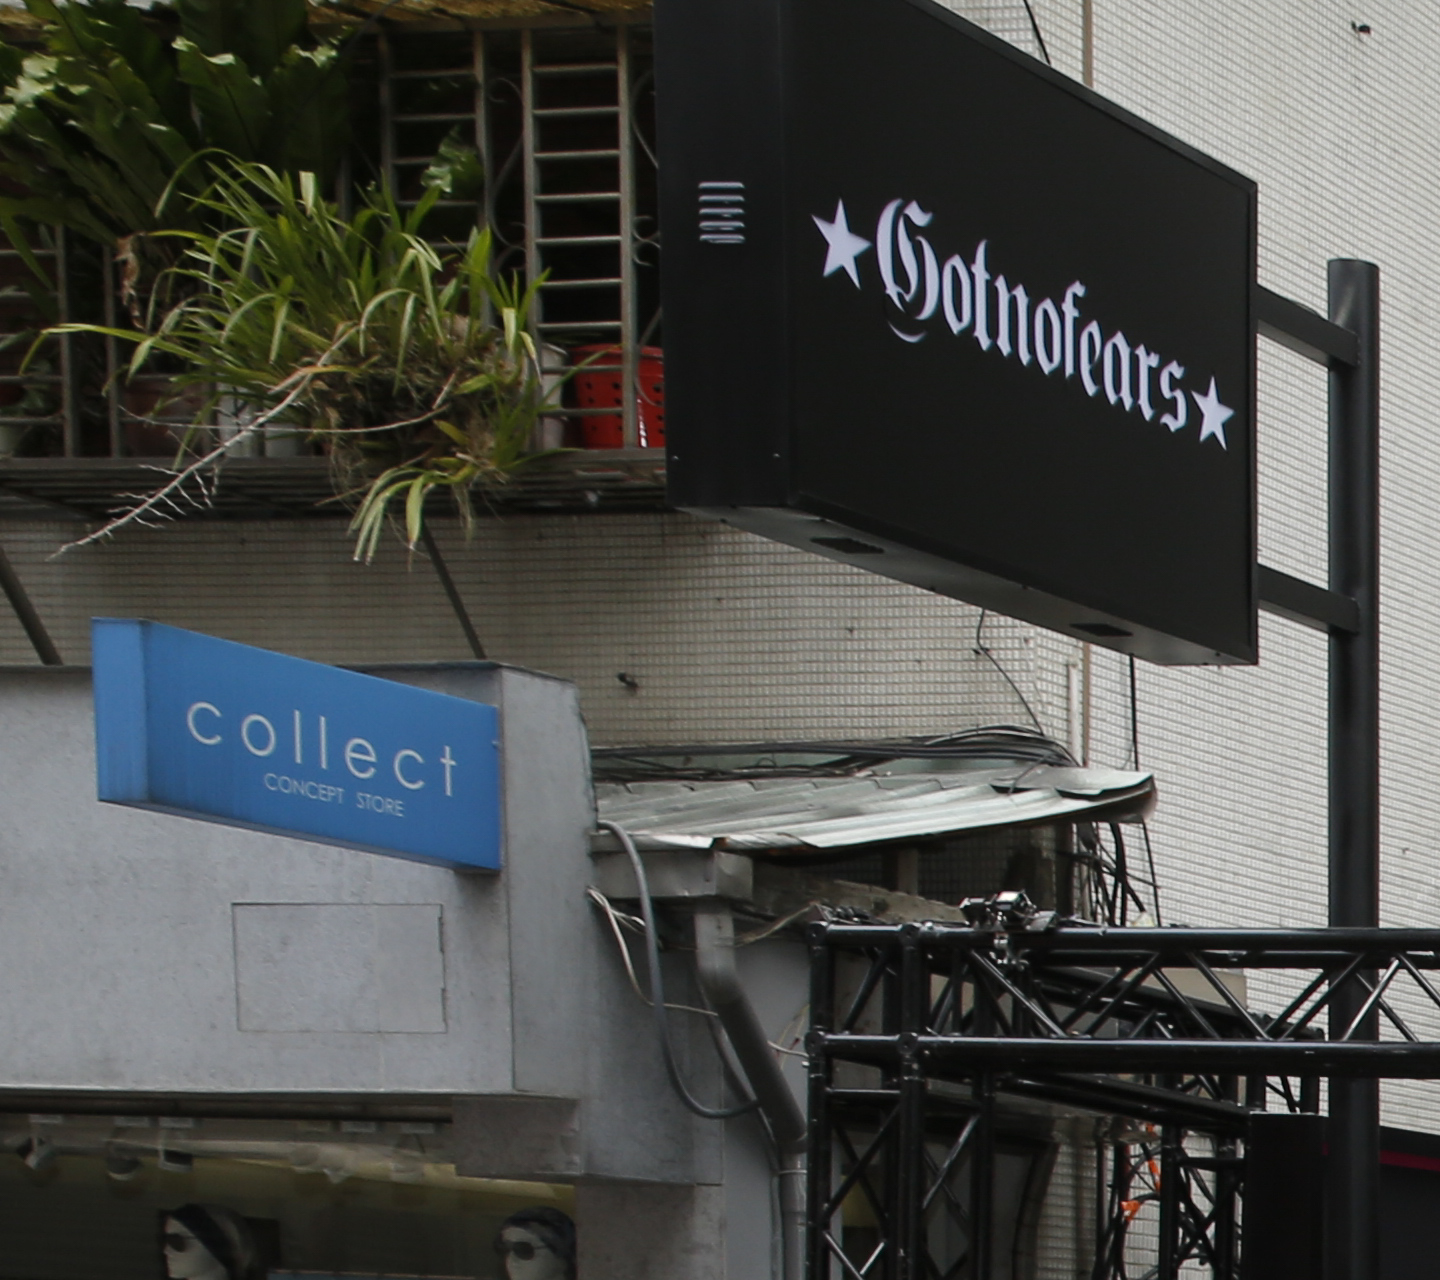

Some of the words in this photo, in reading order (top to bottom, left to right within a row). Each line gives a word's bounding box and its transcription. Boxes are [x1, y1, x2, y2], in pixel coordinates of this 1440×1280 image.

[876, 198, 1187, 432] Gotnofears
[186, 701, 457, 797] collect
[264, 773, 344, 804] CONCEPT
[356, 792, 404, 817] STORE
